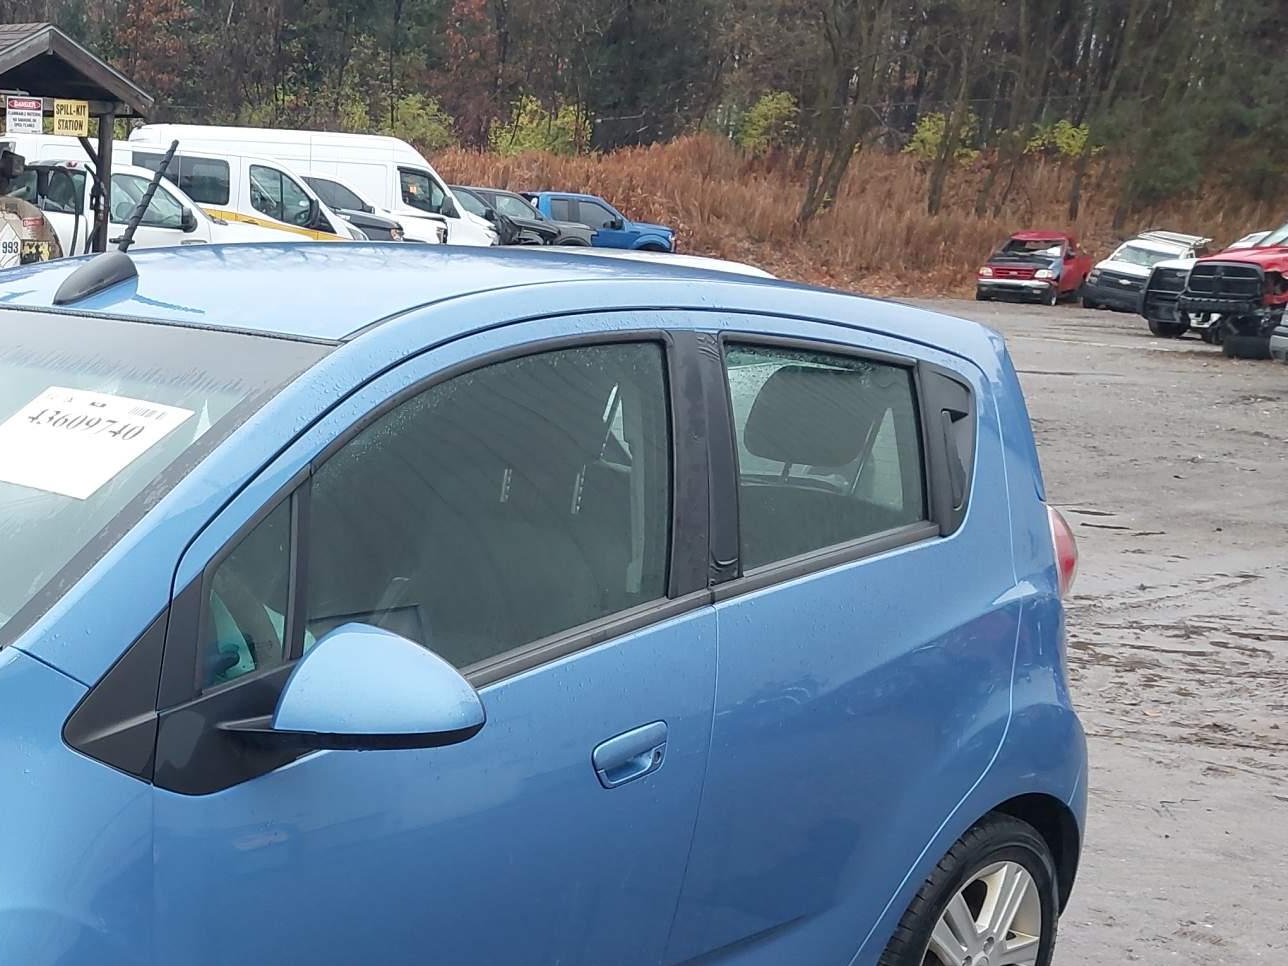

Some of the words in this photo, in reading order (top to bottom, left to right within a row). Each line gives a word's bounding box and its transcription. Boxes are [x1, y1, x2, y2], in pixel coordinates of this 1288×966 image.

[55, 103, 86, 116] SPILL-KIT
[57, 119, 83, 131] STATION
[28, 408, 145, 441] 43609740
